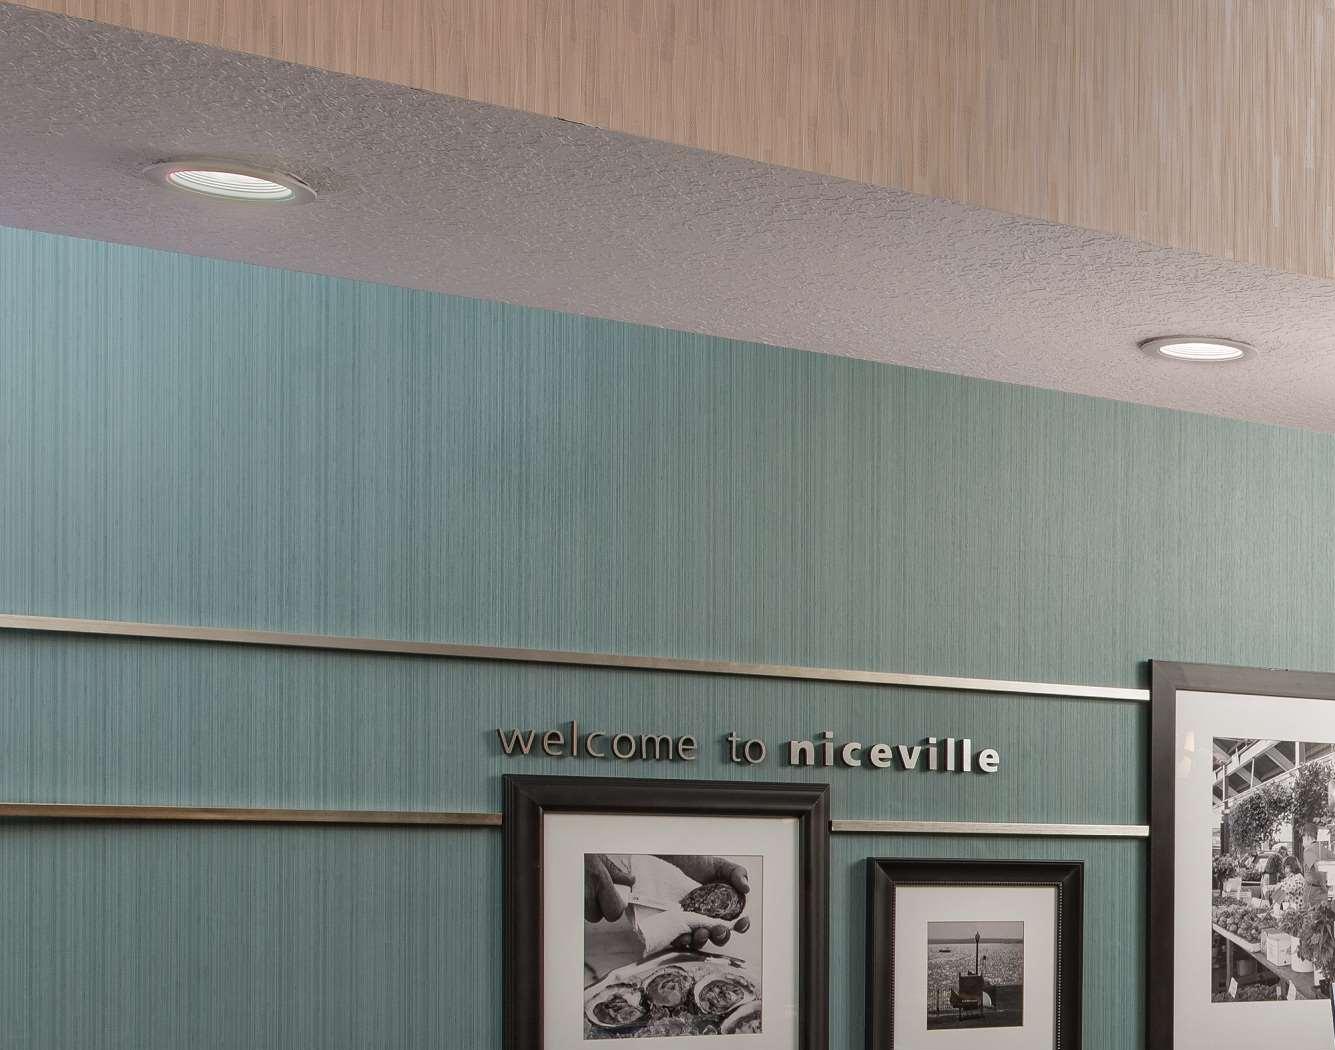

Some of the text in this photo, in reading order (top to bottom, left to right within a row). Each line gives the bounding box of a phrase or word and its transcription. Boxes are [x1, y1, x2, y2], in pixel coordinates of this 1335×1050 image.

[497, 720, 1000, 773] welcome to niceville
